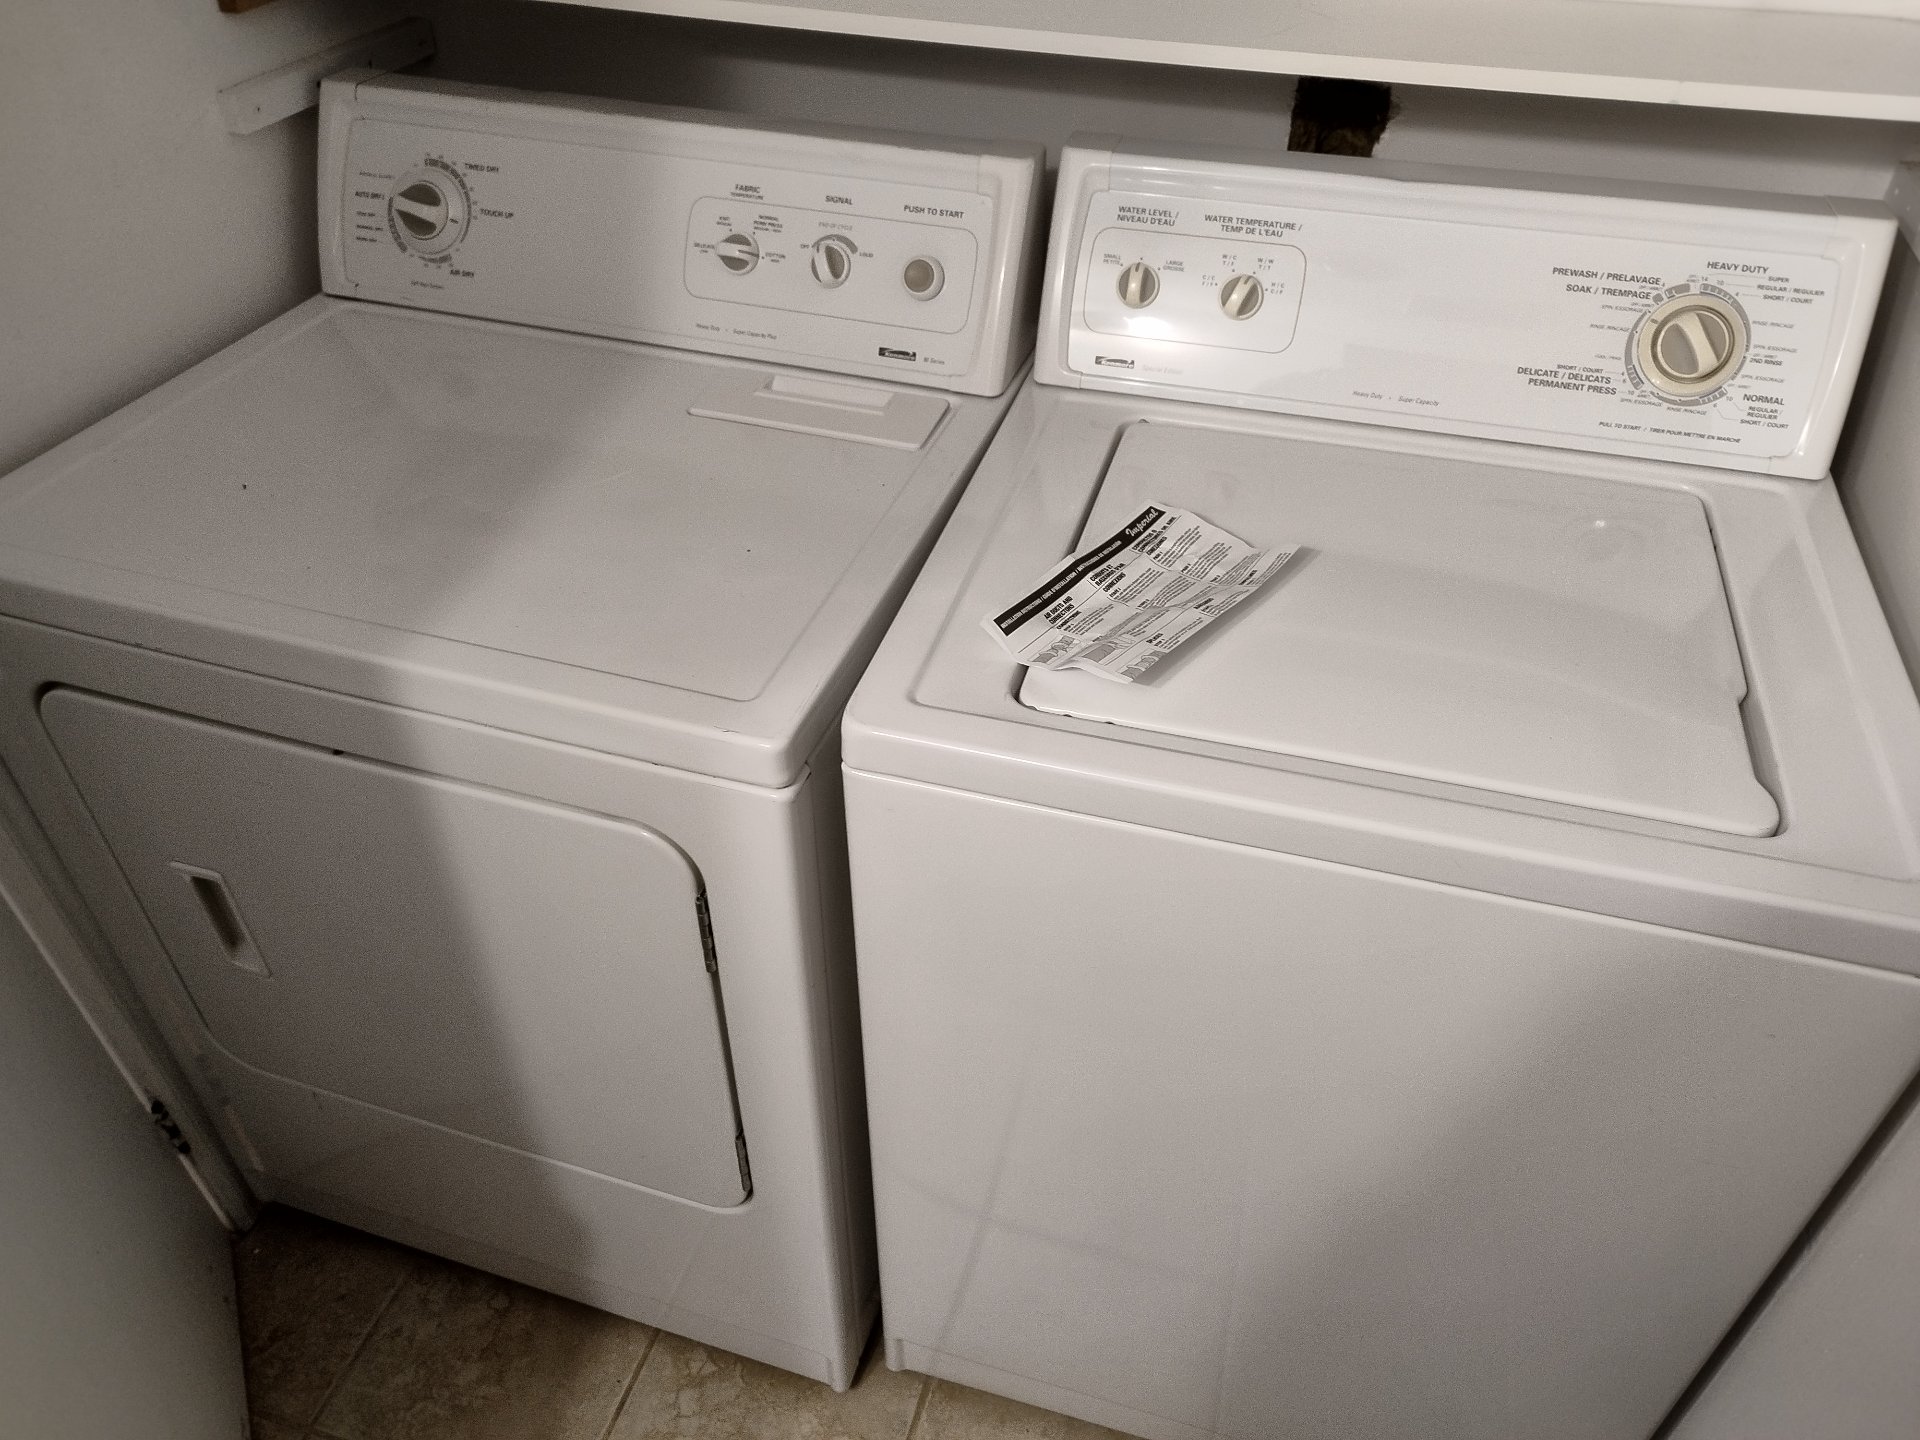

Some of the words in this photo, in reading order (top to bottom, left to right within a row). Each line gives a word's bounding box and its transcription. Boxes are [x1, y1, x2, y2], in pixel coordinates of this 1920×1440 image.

[735, 184, 760, 194] FABRIC
[825, 196, 853, 206] SIGNAL
[904, 204, 926, 214] PUSH
[927, 207, 938, 216] TO
[940, 209, 964, 219] START
[1118, 206, 1146, 215] WATER
[1148, 208, 1173, 218] LEVEL
[1117, 214, 1148, 224] NIVEAU
[1150, 217, 1176, 227] D'EAU
[1204, 214, 1234, 224] WATER
[1236, 217, 1297, 230] TEMPERATURE
[1221, 224, 1244, 233] TEMP
[1258, 228, 1284, 238] L'EAU
[1707, 261, 1739, 271] HEAVY
[1742, 264, 1770, 274] DUTY
[1552, 266, 1598, 279] PREWASH
[1606, 272, 1662, 286] PRELAVAGE
[1566, 284, 1592, 294] SOAK
[1601, 287, 1652, 300] TREMPAGE
[1757, 284, 1788, 292] REGULAR
[1763, 294, 1785, 302] SHORT
[1791, 296, 1814, 304] COURT
[1517, 366, 1560, 379] DELICATE
[1568, 371, 1612, 385] DELICATS
[1528, 378, 1585, 392] PERMANENT
[1587, 385, 1618, 396] PRESS
[1415, 398, 1440, 407] Capacity
[1743, 393, 1785, 406] NORMAL
[1747, 411, 1778, 420] REGULIER
[1748, 405, 1778, 414] REGULAR
[1740, 418, 1762, 428] SHORT
[1767, 422, 1790, 430] COURT
[1623, 424, 1642, 432] START
[1684, 432, 1706, 440] METTRE
[1716, 436, 1742, 444] MARCHE
[1126, 508, 1158, 536] Imperial
[1043, 610, 1052, 619] AIR
[1062, 594, 1073, 605] AND
[1048, 602, 1074, 624] CONNECTORS
